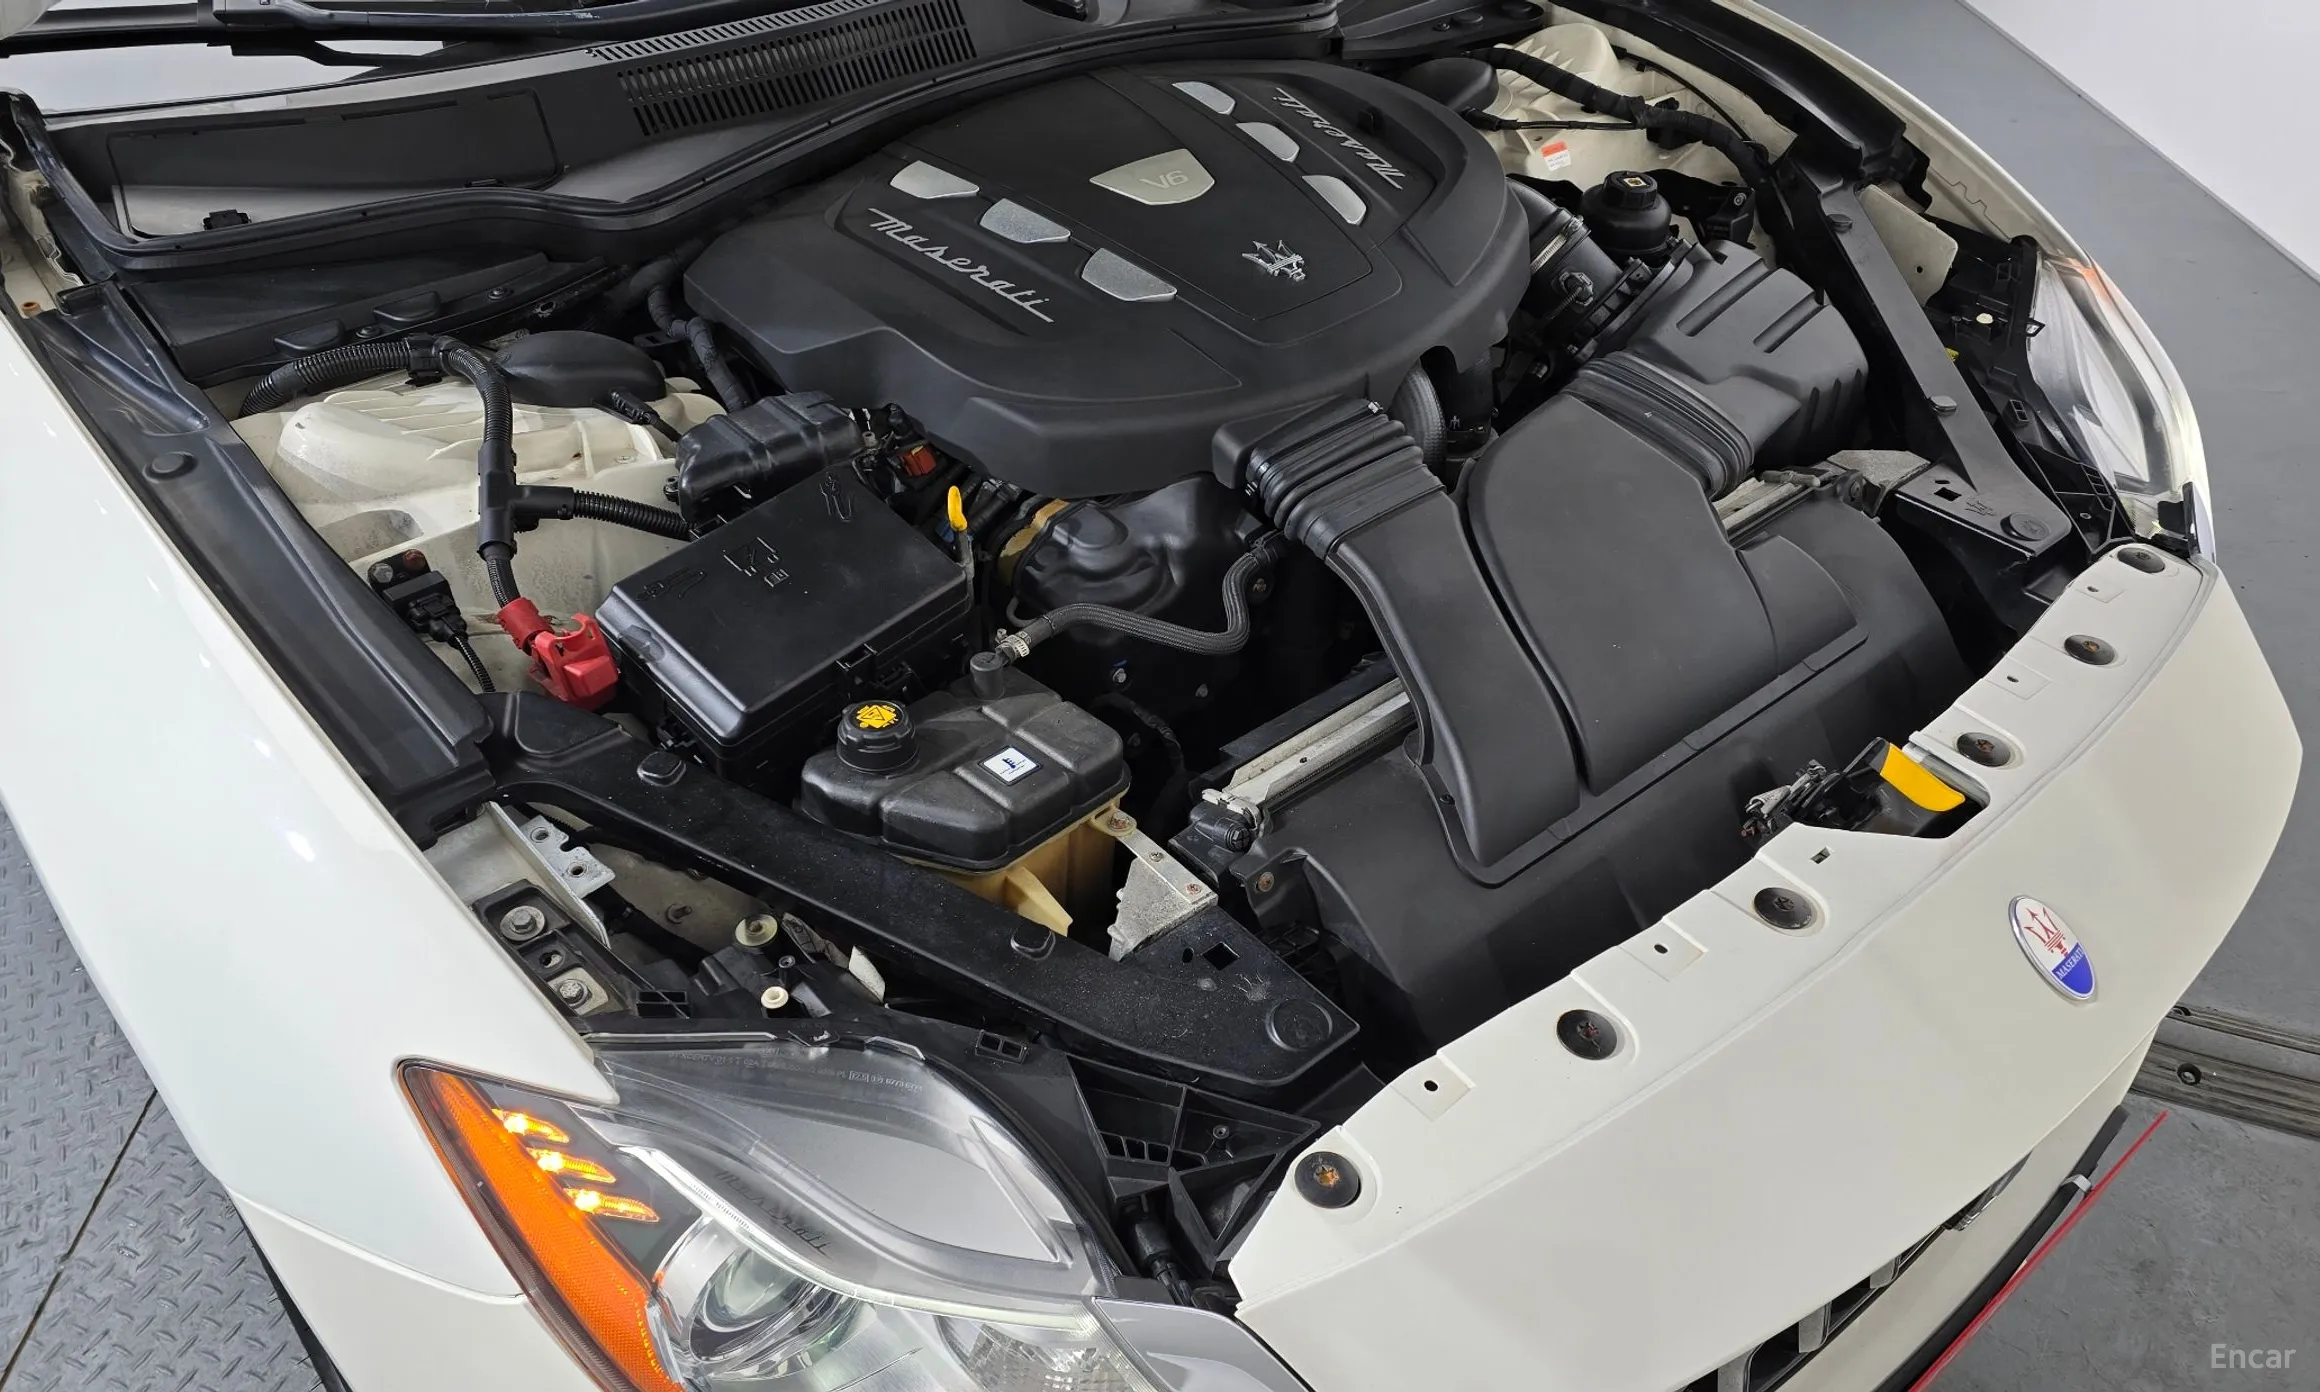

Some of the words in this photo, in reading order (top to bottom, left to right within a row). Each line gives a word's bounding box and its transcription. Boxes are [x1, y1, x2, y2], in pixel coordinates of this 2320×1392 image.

[1139, 169, 1189, 190] V6
[1272, 87, 1405, 190] Maserati
[868, 207, 1054, 323] Maserati
